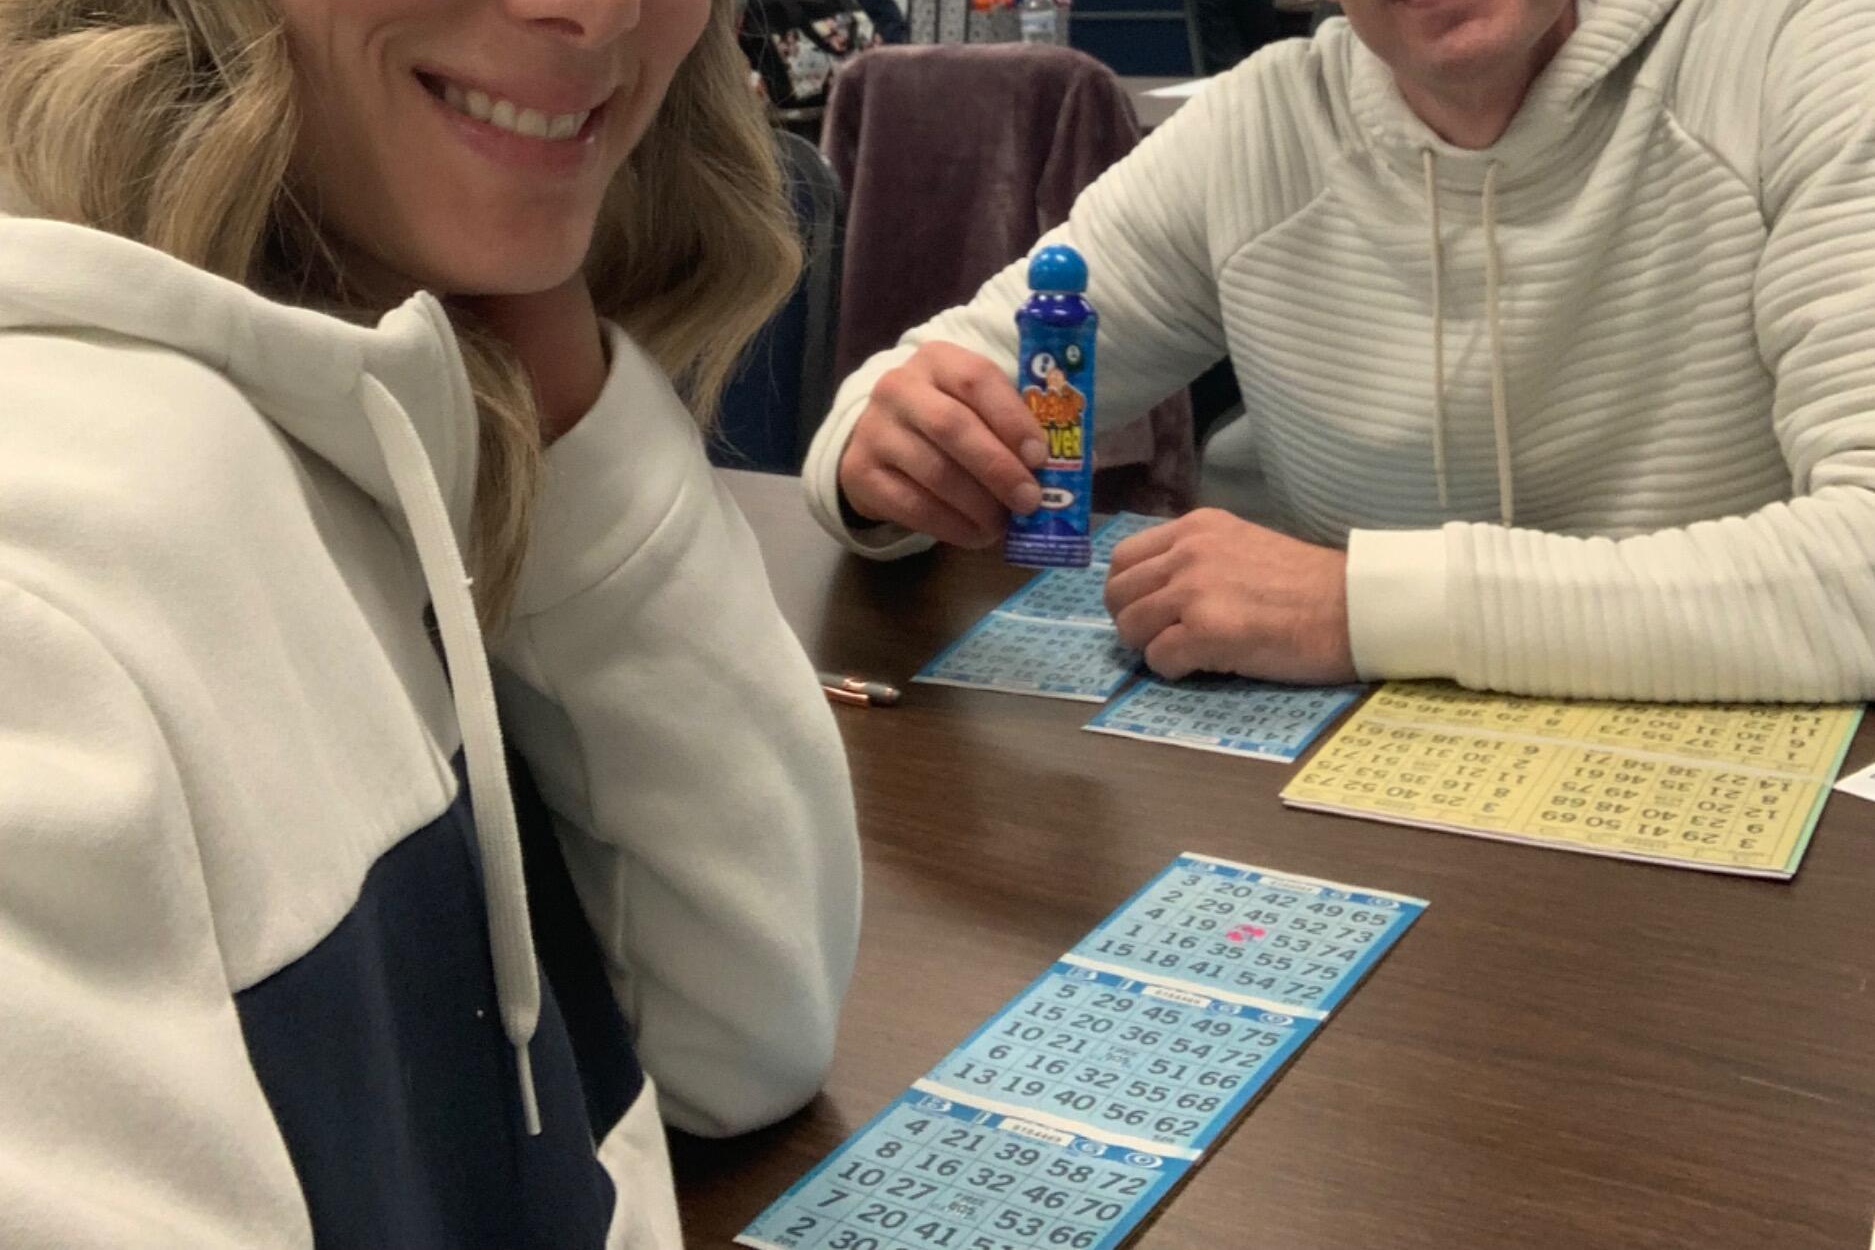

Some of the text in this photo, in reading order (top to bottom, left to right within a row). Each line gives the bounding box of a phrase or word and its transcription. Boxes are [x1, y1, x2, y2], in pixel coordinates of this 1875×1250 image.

[1332, 748, 1360, 760] 71
[1371, 754, 1400, 766] 51
[1456, 765, 1487, 778] 21
[1582, 752, 1792, 792] 14 27 38 58 71
[1303, 773, 1500, 813] 3 25 40 52 73
[1318, 760, 1510, 798] 8 16 35 53 75
[1498, 772, 1528, 784] 11
[1561, 780, 1595, 794] 75
[1574, 766, 1778, 805] 8 21 35 46 61
[1604, 786, 1640, 800] 49
[1541, 810, 1577, 822] 69
[1550, 795, 1764, 834] 9 23 40 48 68
[1585, 816, 1622, 830] 50
[1697, 800, 1734, 814] 20
[1744, 807, 1779, 820] 12
[1638, 824, 1670, 836] 41
[1682, 830, 1720, 844] 29
[1740, 838, 1758, 849] 3
[1162, 890, 1374, 943] 2 29 45 52 73
[1182, 875, 1201, 886] 3
[1214, 882, 1252, 898] 20
[1261, 894, 1298, 908] 42
[1306, 903, 1343, 917] 49
[1351, 911, 1387, 926] 65
[1126, 924, 1338, 980] 1 16 35 55 75
[1145, 908, 1357, 961] 4 19 53 74
[1096, 940, 1323, 999] 15 18 41 54 72
[1055, 984, 1280, 1046] 5 29 45 49 75
[1024, 1002, 1262, 1068] 15 20 36 54 72
[1003, 1022, 1242, 1089] 10 21 51 66
[988, 1045, 1221, 1112] 6 16 32 55 68
[954, 1063, 1199, 1136] 13 19 40 56 62
[904, 1120, 930, 1136] 4
[941, 1130, 985, 1151] 21
[994, 1143, 1040, 1166] 39
[1046, 1158, 1094, 1183] 58
[1098, 1172, 1147, 1195] 72
[876, 1141, 1122, 1222] 8 16 32 46 70
[817, 1190, 957, 1246] 7 20 41
[838, 1162, 1098, 1248] 10 27 53 66
[786, 1216, 816, 1238] 2
